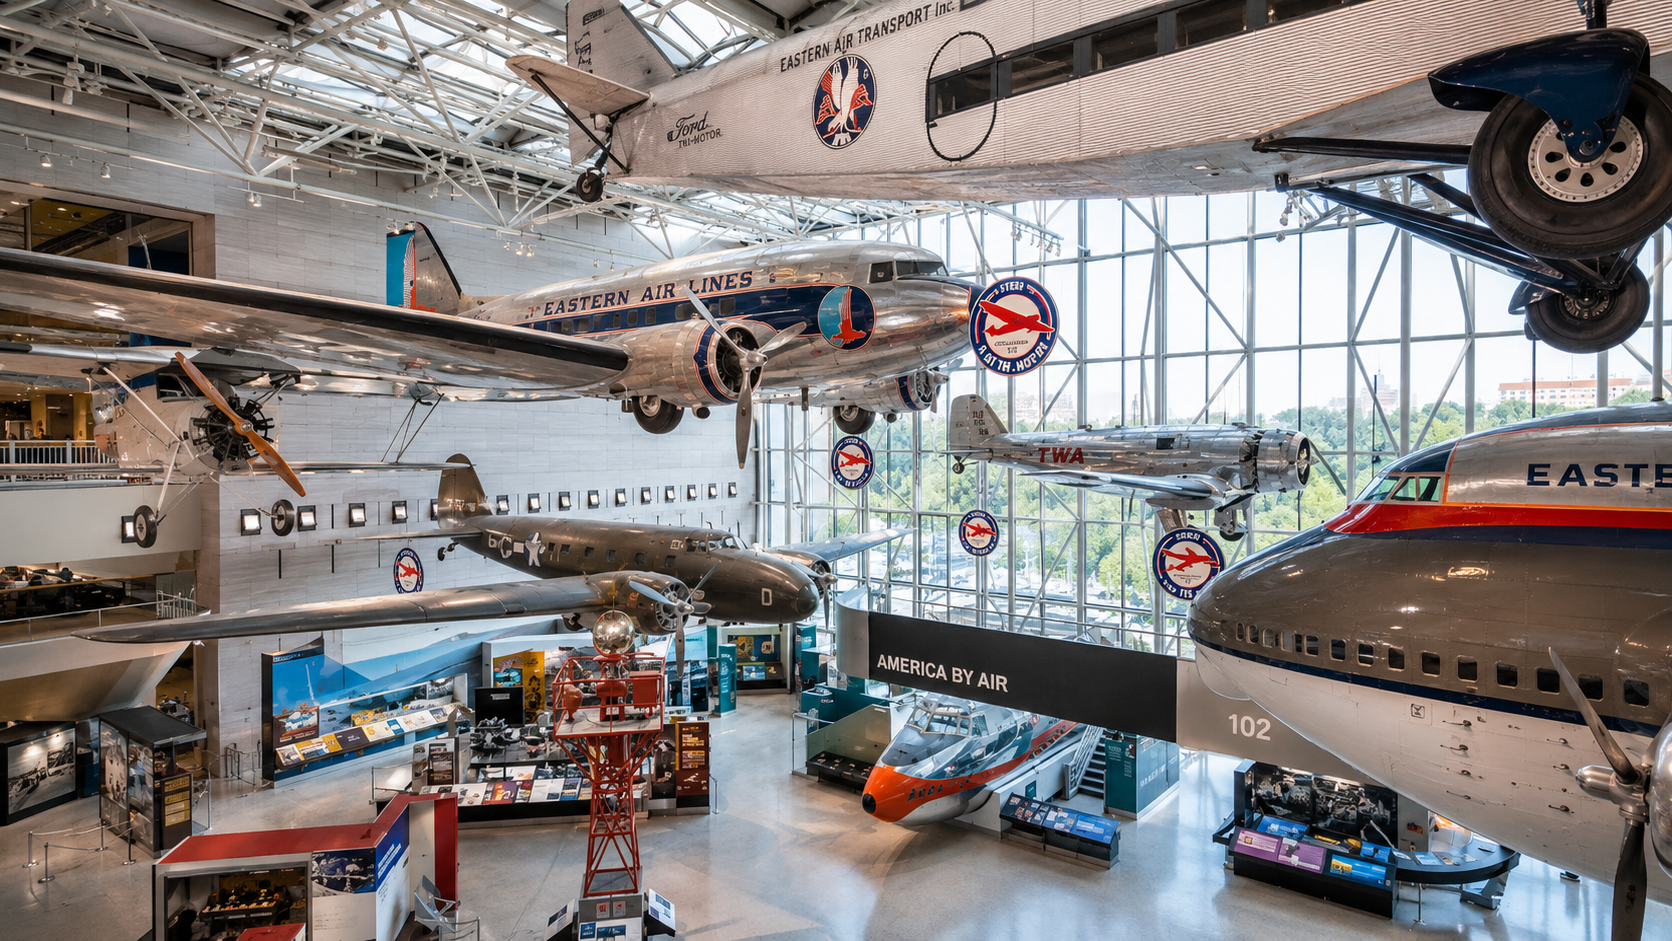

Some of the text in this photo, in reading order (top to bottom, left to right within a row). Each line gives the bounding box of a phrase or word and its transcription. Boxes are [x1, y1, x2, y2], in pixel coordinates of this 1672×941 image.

[780, 2, 955, 73] EASTERN AIR TRANSPORT Inc.
[667, 111, 709, 142] Ford
[544, 270, 753, 316] EASTERN AIR LINES
[1038, 447, 1084, 464] TWA
[877, 653, 1009, 693] AMERICA BY AIR
[1228, 713, 1271, 741] 102
